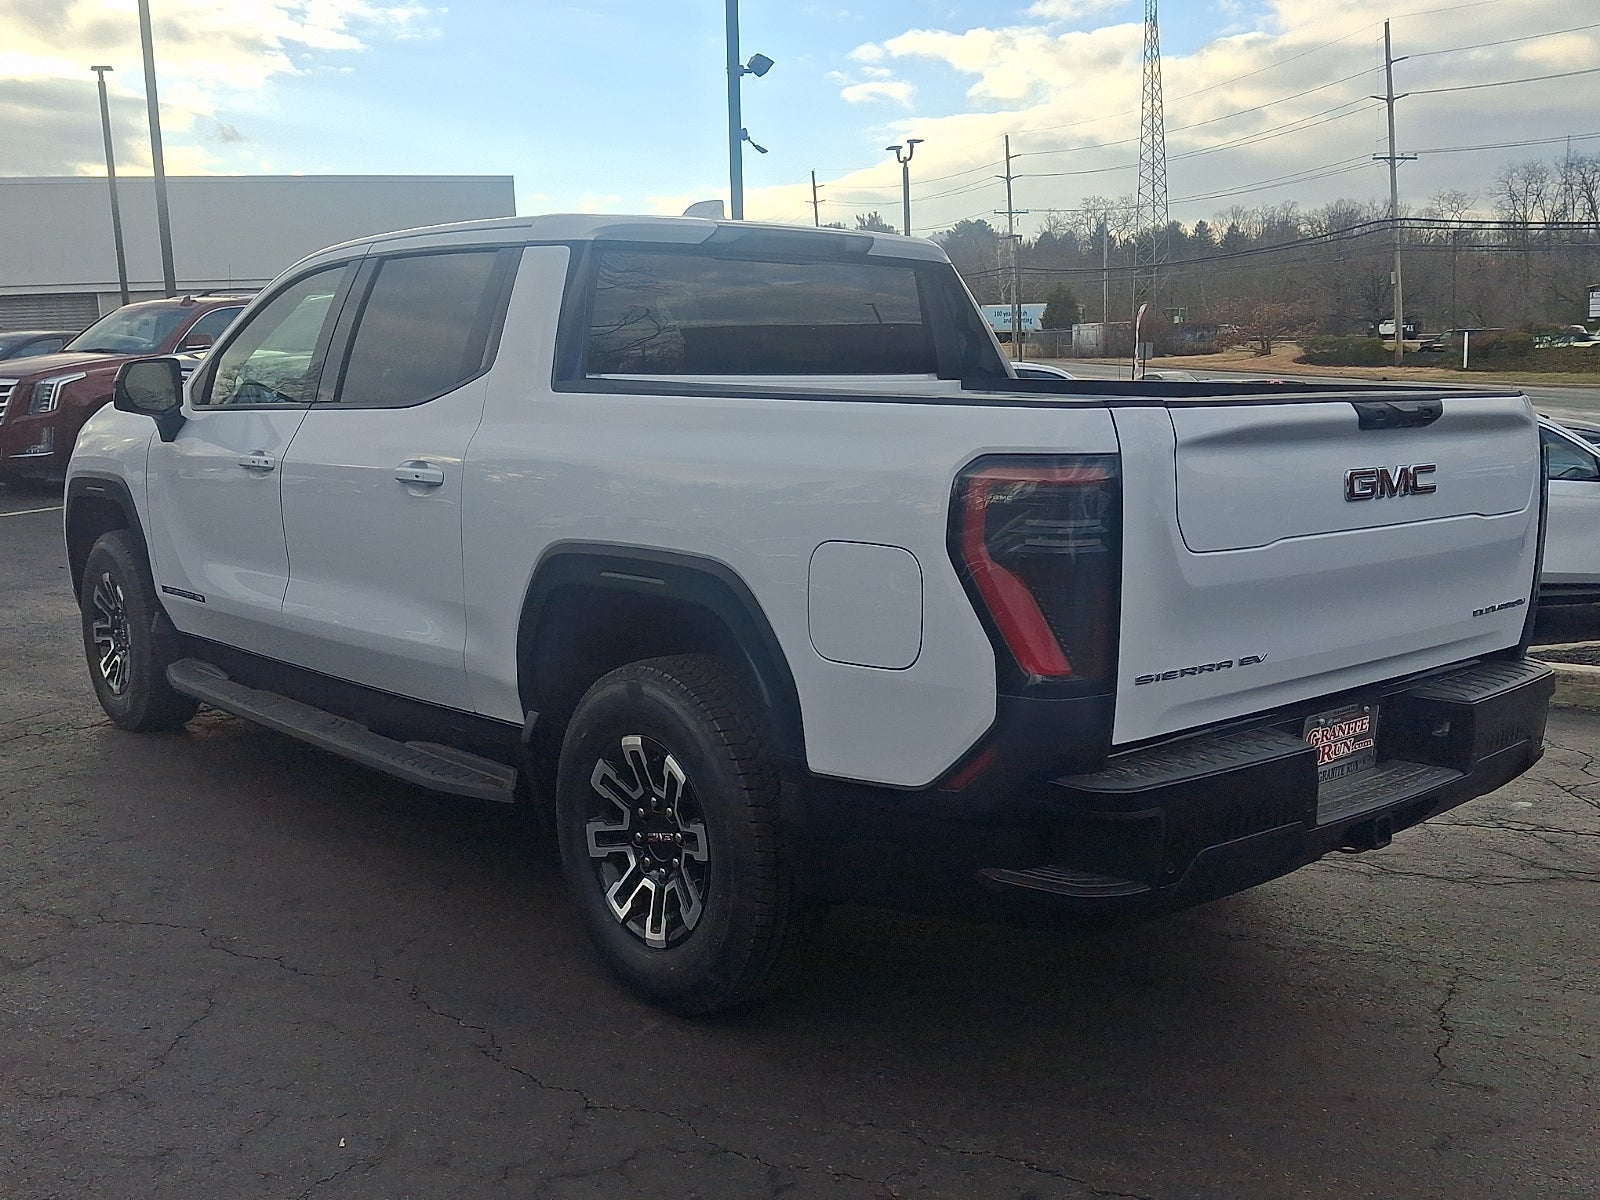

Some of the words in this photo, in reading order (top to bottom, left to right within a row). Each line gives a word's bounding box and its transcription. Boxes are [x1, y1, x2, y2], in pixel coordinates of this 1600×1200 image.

[1344, 462, 1436, 502] GMC
[1134, 659, 1234, 686] SIERRA
[1238, 652, 1269, 667] EV
[1306, 717, 1369, 748] GRANITE
